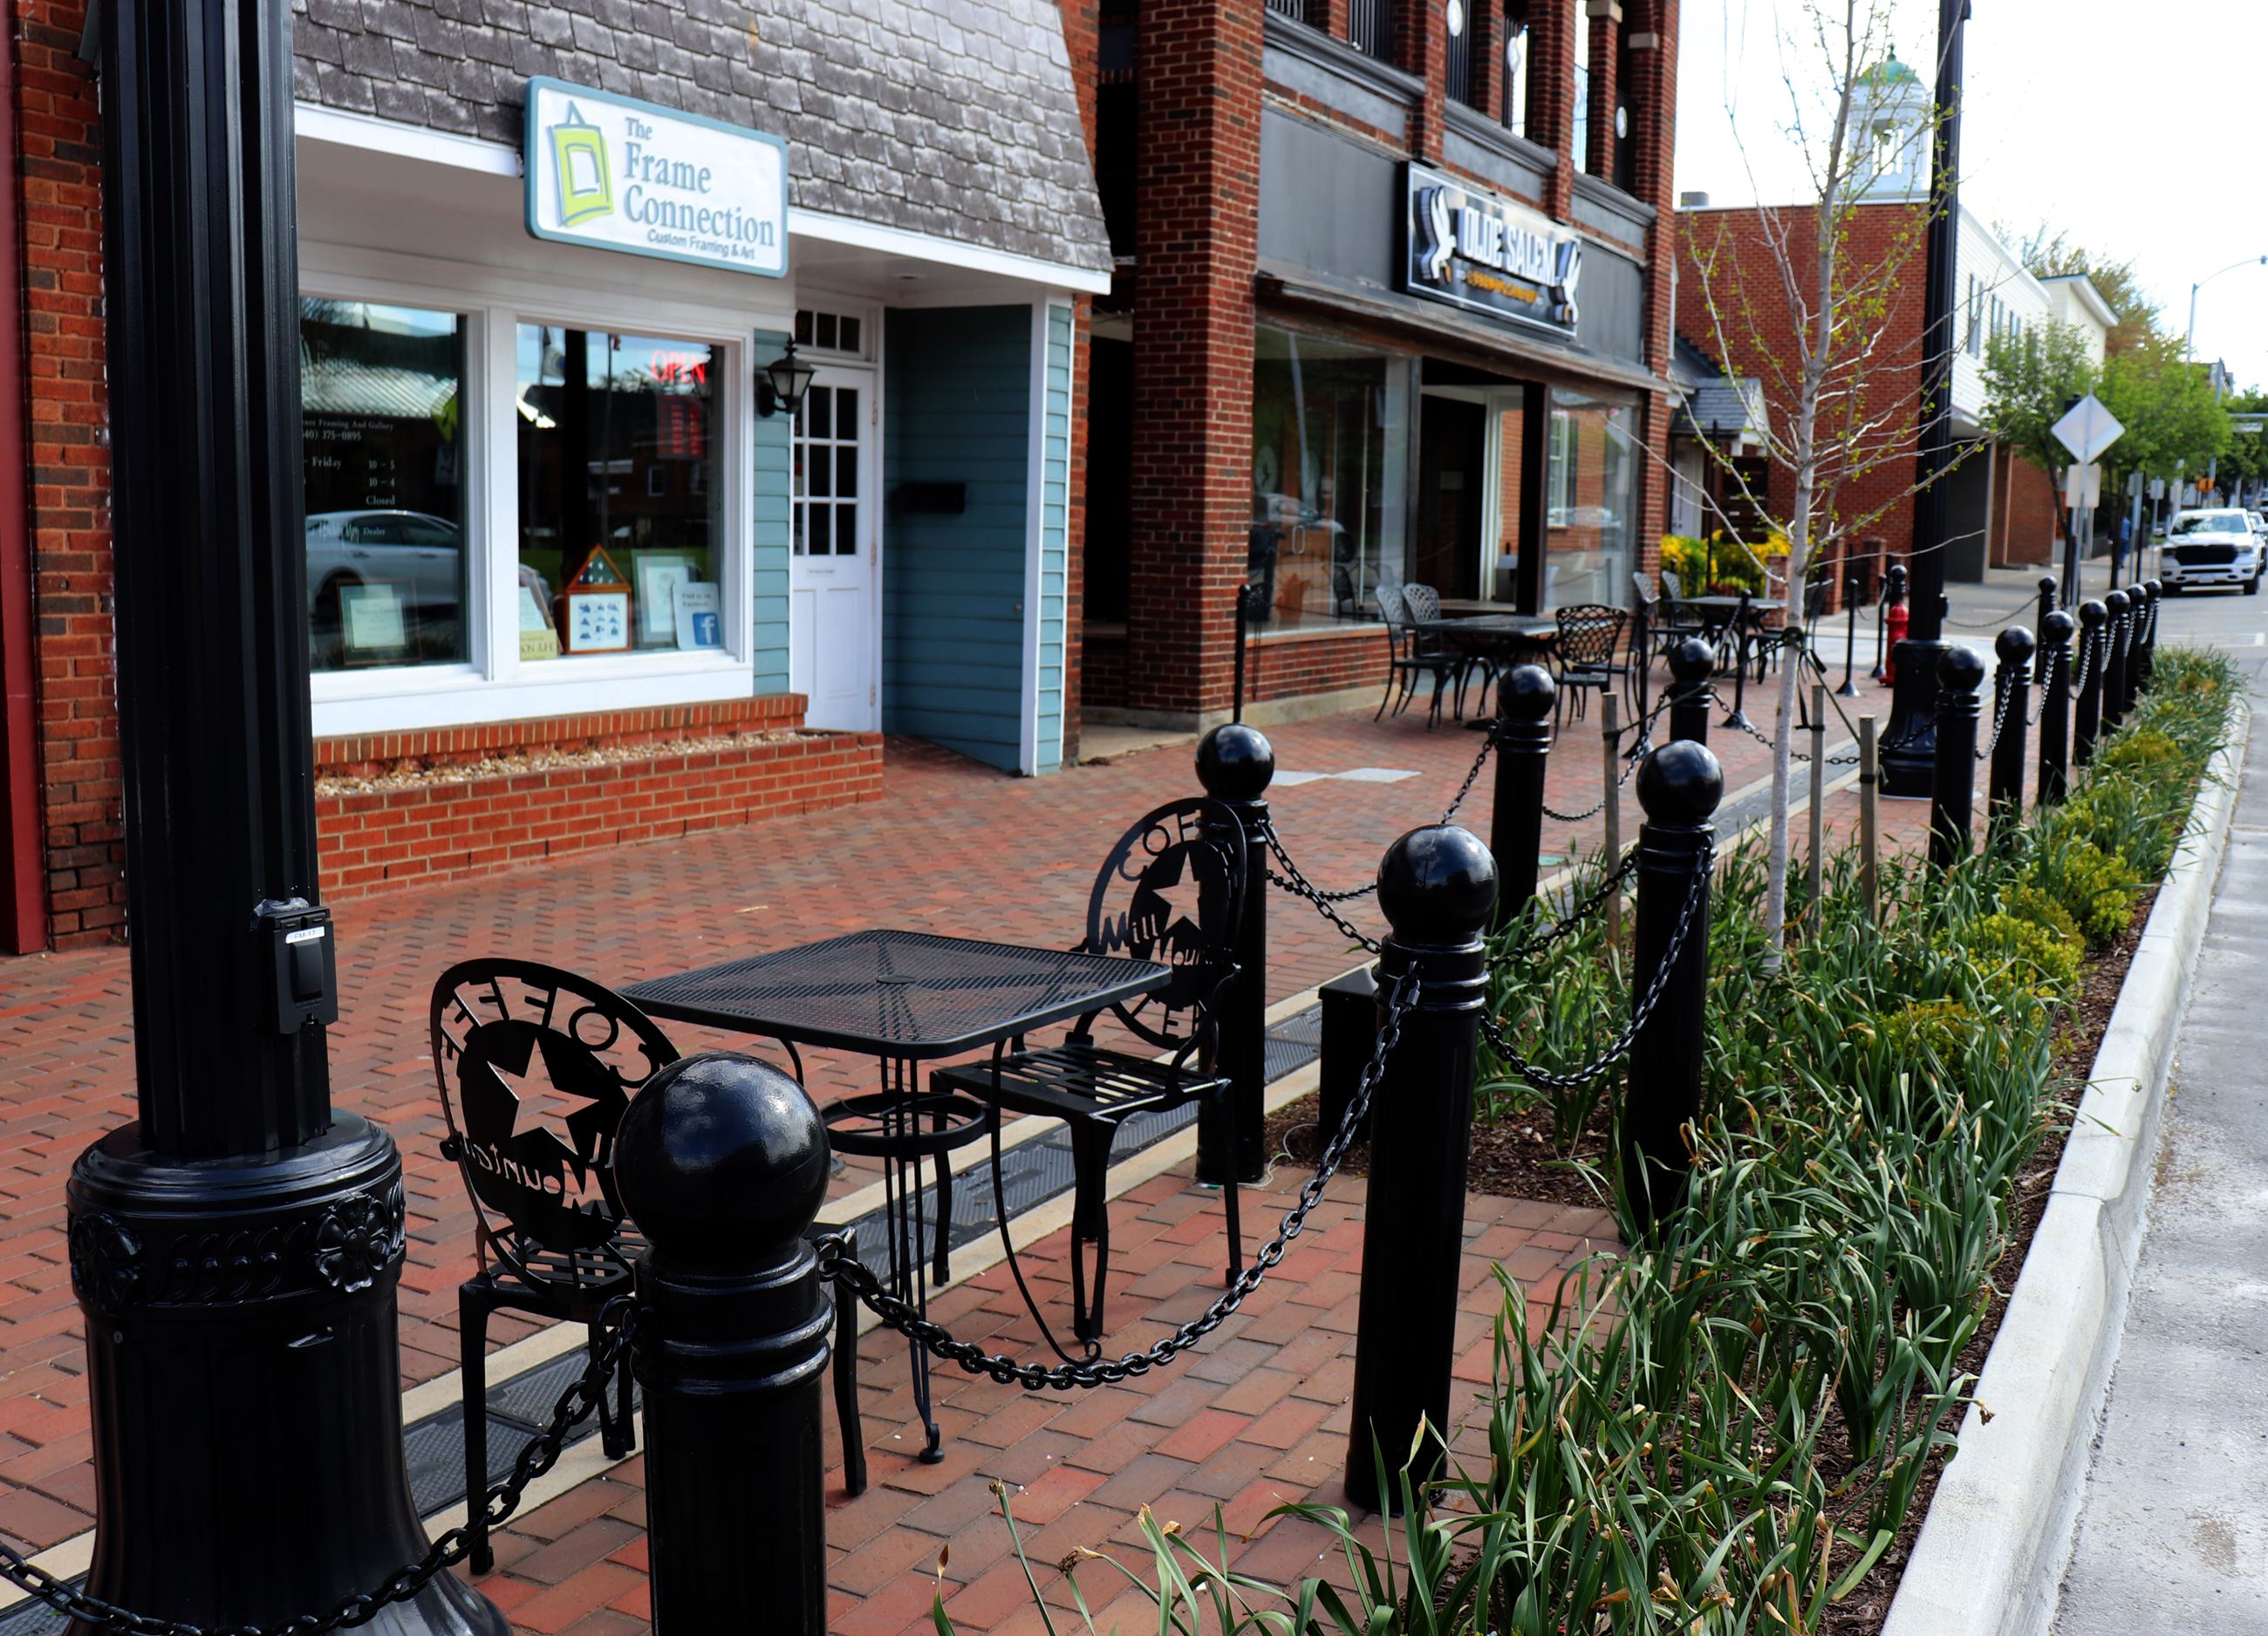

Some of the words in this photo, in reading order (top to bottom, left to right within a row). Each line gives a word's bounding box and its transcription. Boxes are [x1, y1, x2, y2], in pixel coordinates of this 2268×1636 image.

[625, 117, 652, 140] The
[624, 141, 712, 194] Frame
[624, 184, 775, 247] Connection
[648, 228, 687, 247] Custom
[689, 235, 729, 257] Framing
[740, 246, 755, 260] Art
[1462, 206, 1503, 269] OLDE
[1505, 223, 1557, 287] SALEM
[650, 349, 707, 385] OPEN
[312, 457, 342, 469] Friday
[369, 460, 378, 470] 10
[369, 477, 378, 487] 10
[365, 494, 396, 506] Closed
[363, 527, 386, 535] Dealer
